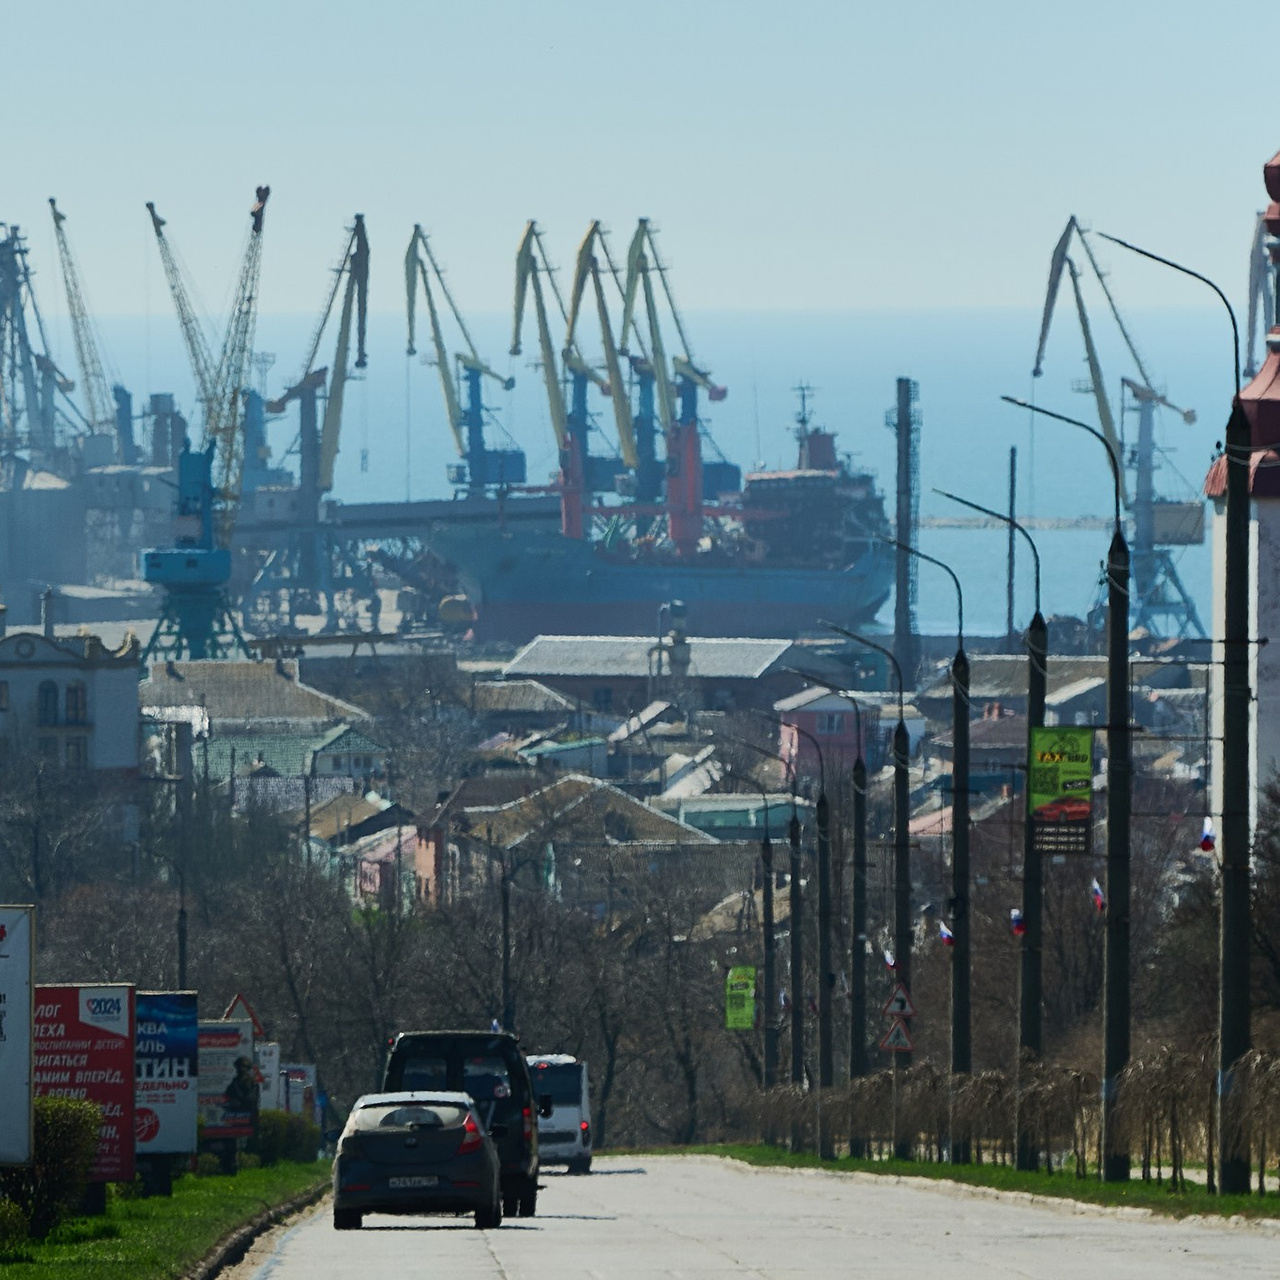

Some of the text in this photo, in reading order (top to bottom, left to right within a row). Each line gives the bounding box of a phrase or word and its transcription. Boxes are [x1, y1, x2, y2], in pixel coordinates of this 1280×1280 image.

[34, 1004, 62, 1019] ЛОГ
[92, 998, 121, 1015] 2024
[137, 1022, 168, 1035] КВА
[135, 1057, 190, 1079] ТИН
